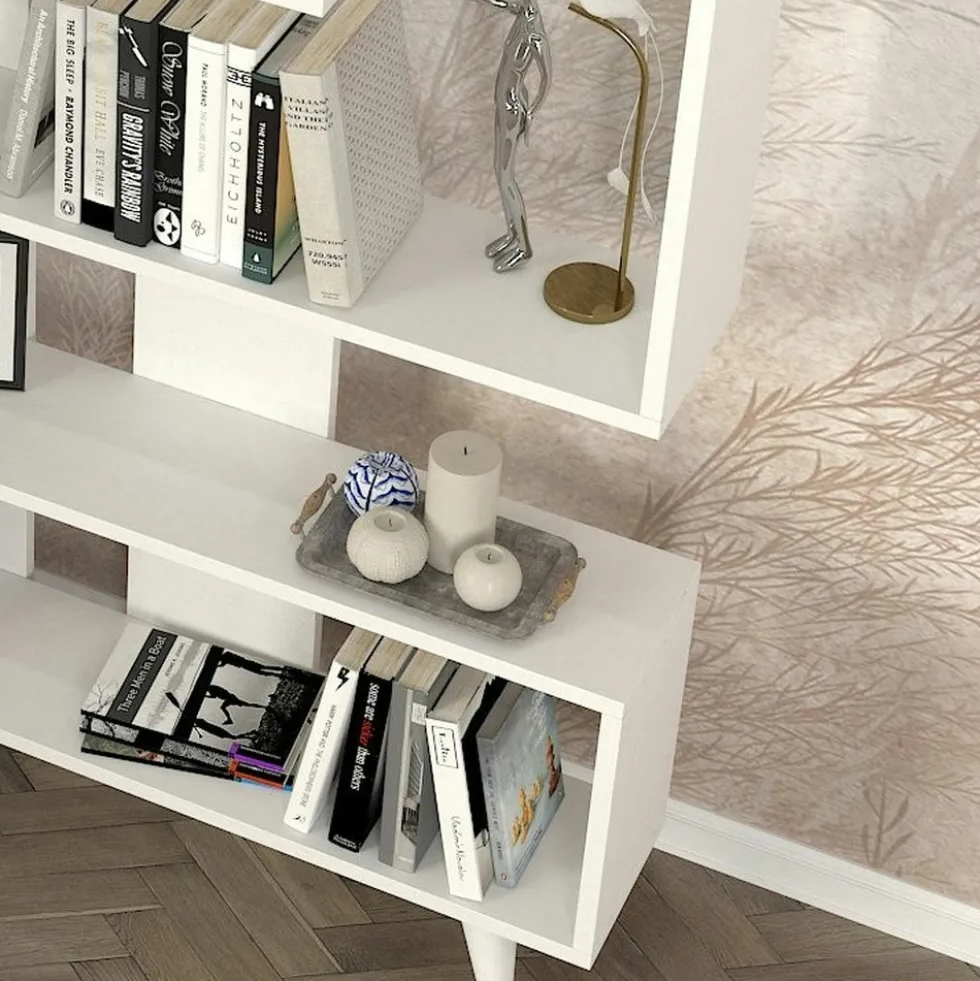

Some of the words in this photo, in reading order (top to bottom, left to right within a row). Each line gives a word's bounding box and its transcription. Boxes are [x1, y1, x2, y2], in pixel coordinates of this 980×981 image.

[67, 20, 75, 36] THE
[67, 38, 75, 56] BIG
[66, 58, 75, 86] SLEEP
[161, 41, 184, 97] Snow
[199, 82, 208, 107] MORAND
[65, 95, 75, 146] RAYMOND
[159, 100, 181, 156] White
[258, 122, 267, 138] THE
[121, 113, 143, 171] GRAVITY'S
[63, 147, 74, 194] CHANDLER
[226, 98, 243, 224] EICHHOLTZ
[256, 141, 265, 186] MYSTERIOUS
[120, 170, 142, 223] RAINBOW
[254, 188, 263, 214] ISLAND
[117, 688, 138, 712] Three
[131, 670, 148, 689] Men
[141, 661, 153, 670] in
[148, 636, 167, 655] Boat
[367, 682, 380, 706] some
[364, 706, 375, 721] are
[356, 746, 370, 765] than
[350, 765, 366, 791] others
